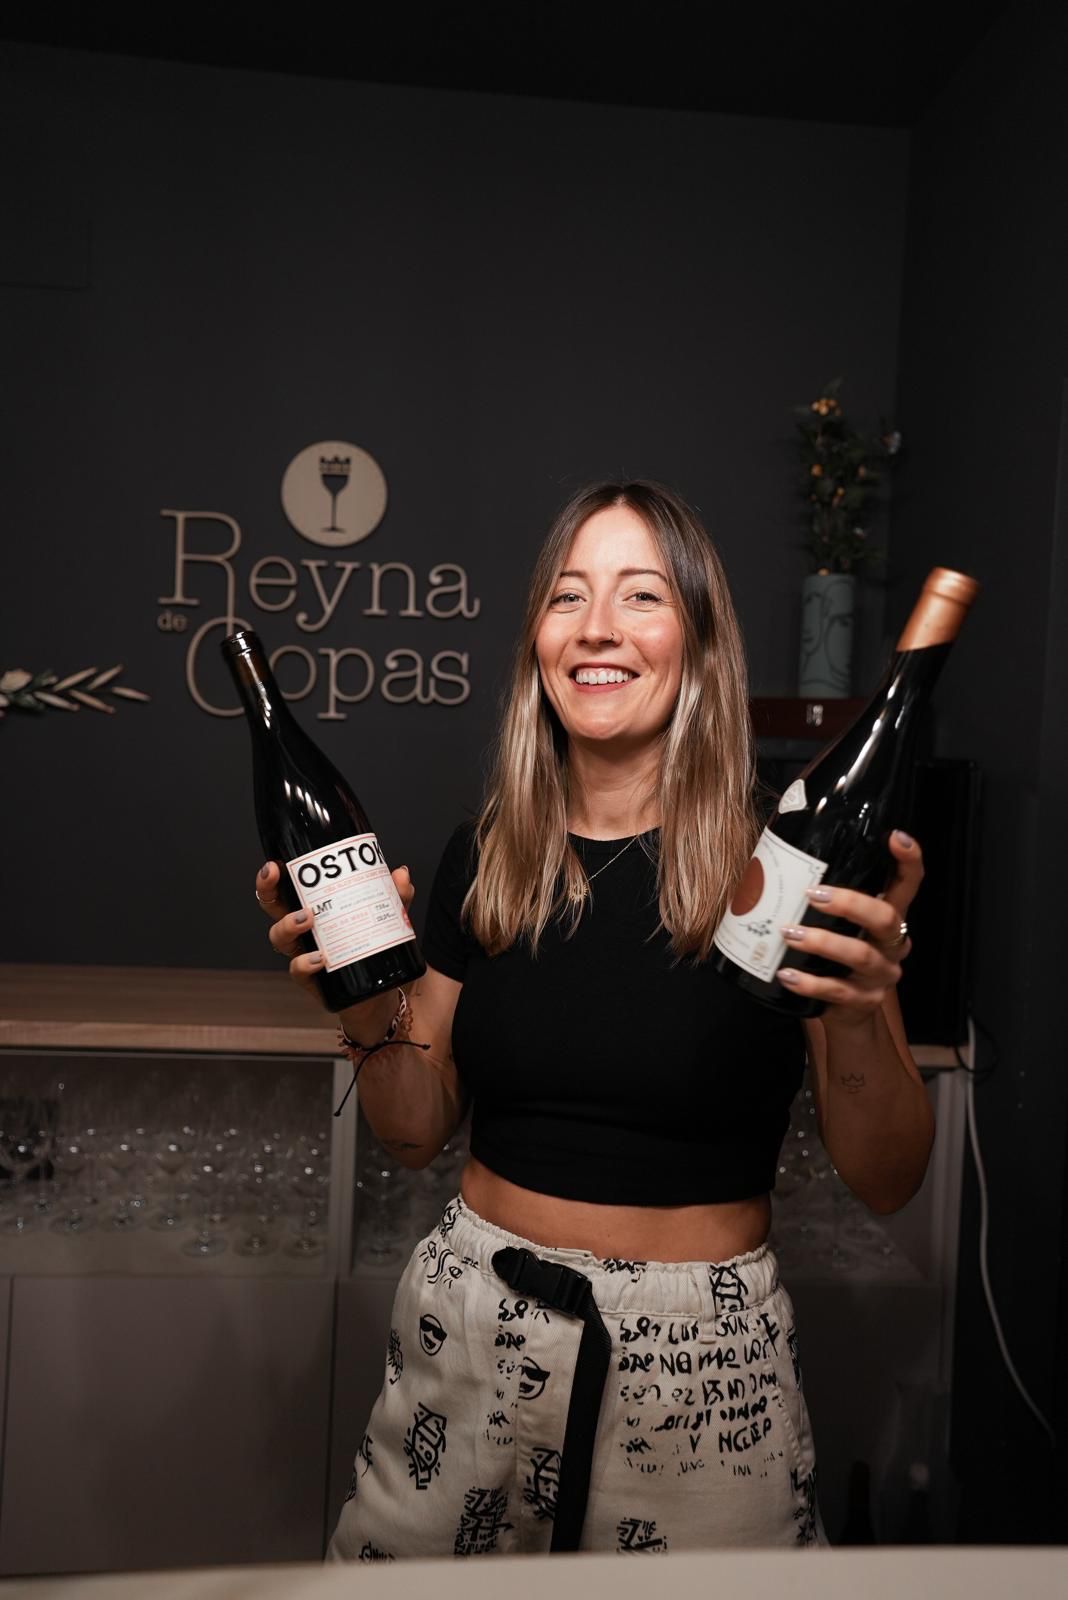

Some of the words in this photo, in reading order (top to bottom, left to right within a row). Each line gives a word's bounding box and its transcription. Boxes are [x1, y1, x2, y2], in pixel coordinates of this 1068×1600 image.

[158, 508, 481, 637] Reyna
[157, 612, 187, 631] de
[186, 617, 471, 720] Copas
[311, 899, 333, 916] LMT
